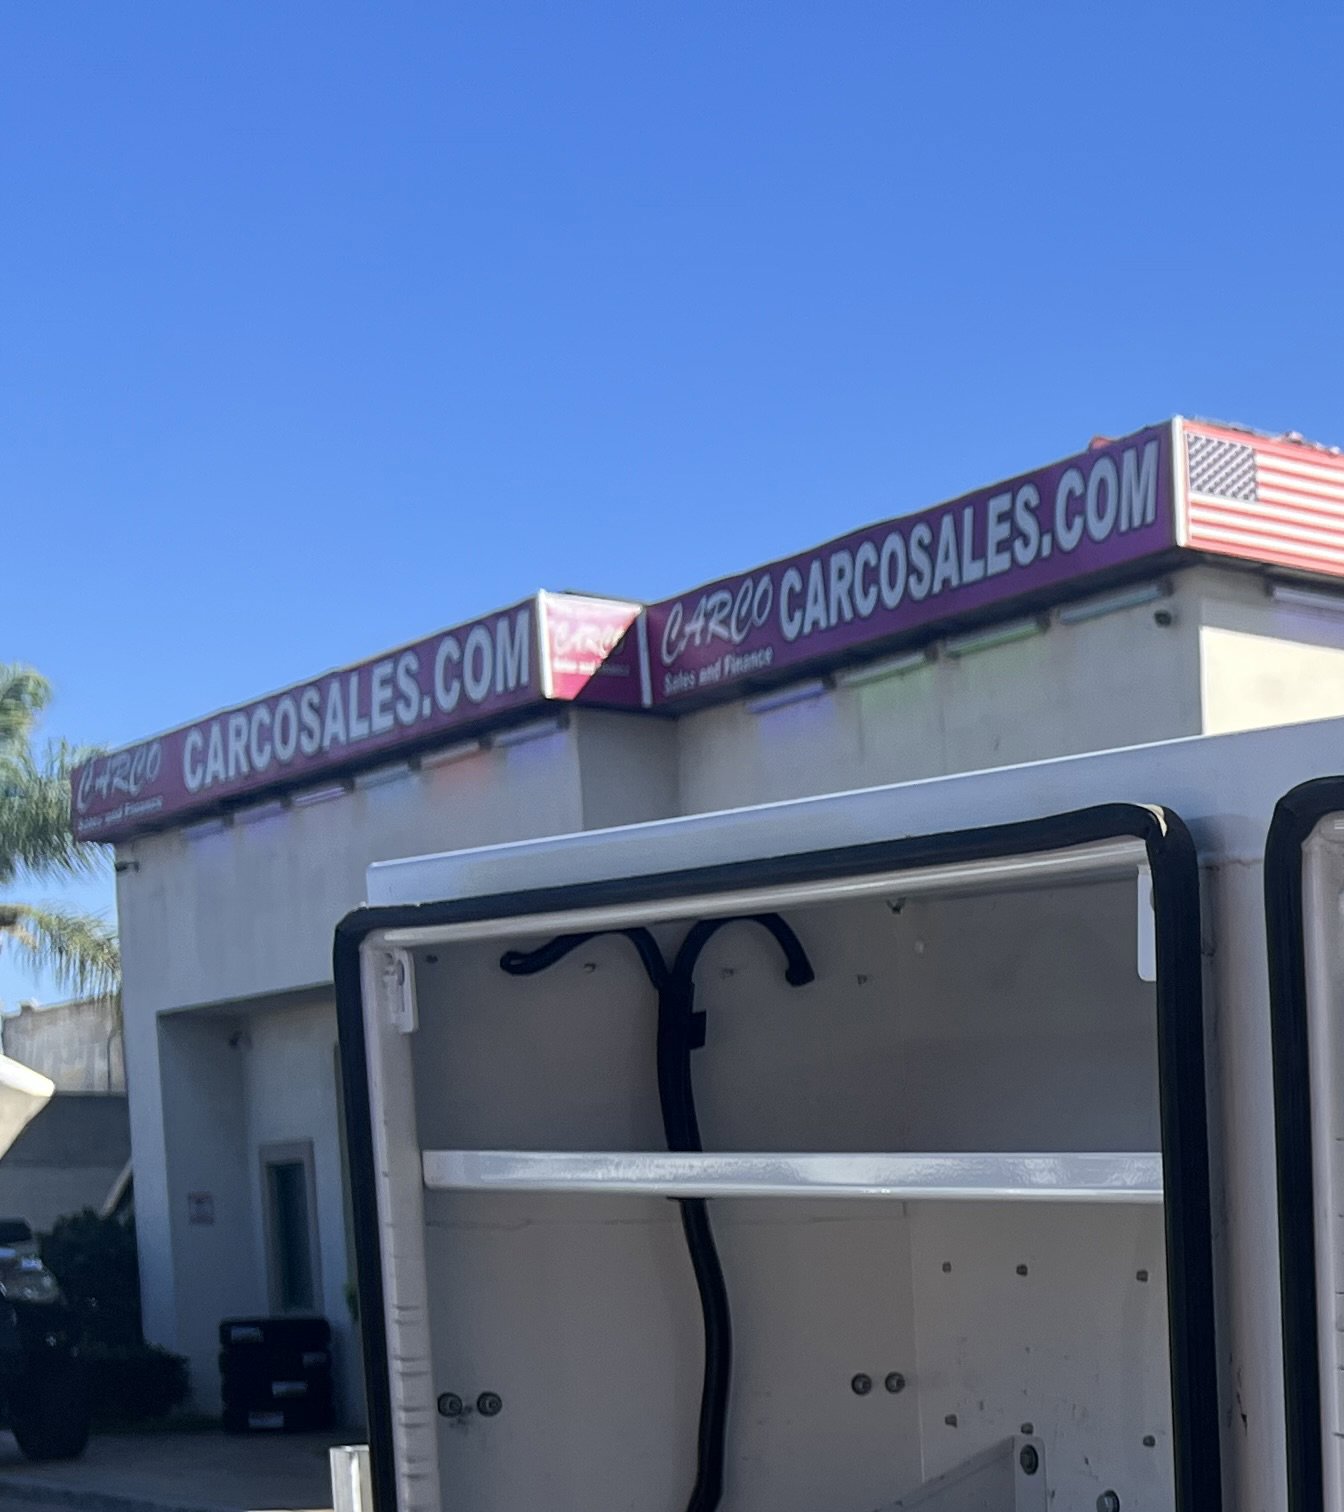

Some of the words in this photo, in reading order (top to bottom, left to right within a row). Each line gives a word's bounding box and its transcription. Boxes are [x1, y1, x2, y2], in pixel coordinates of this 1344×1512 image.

[661, 579, 774, 666] CARCO
[779, 440, 1160, 641] CARCOSALES.COM
[183, 609, 530, 793] CARCOSALES.COM
